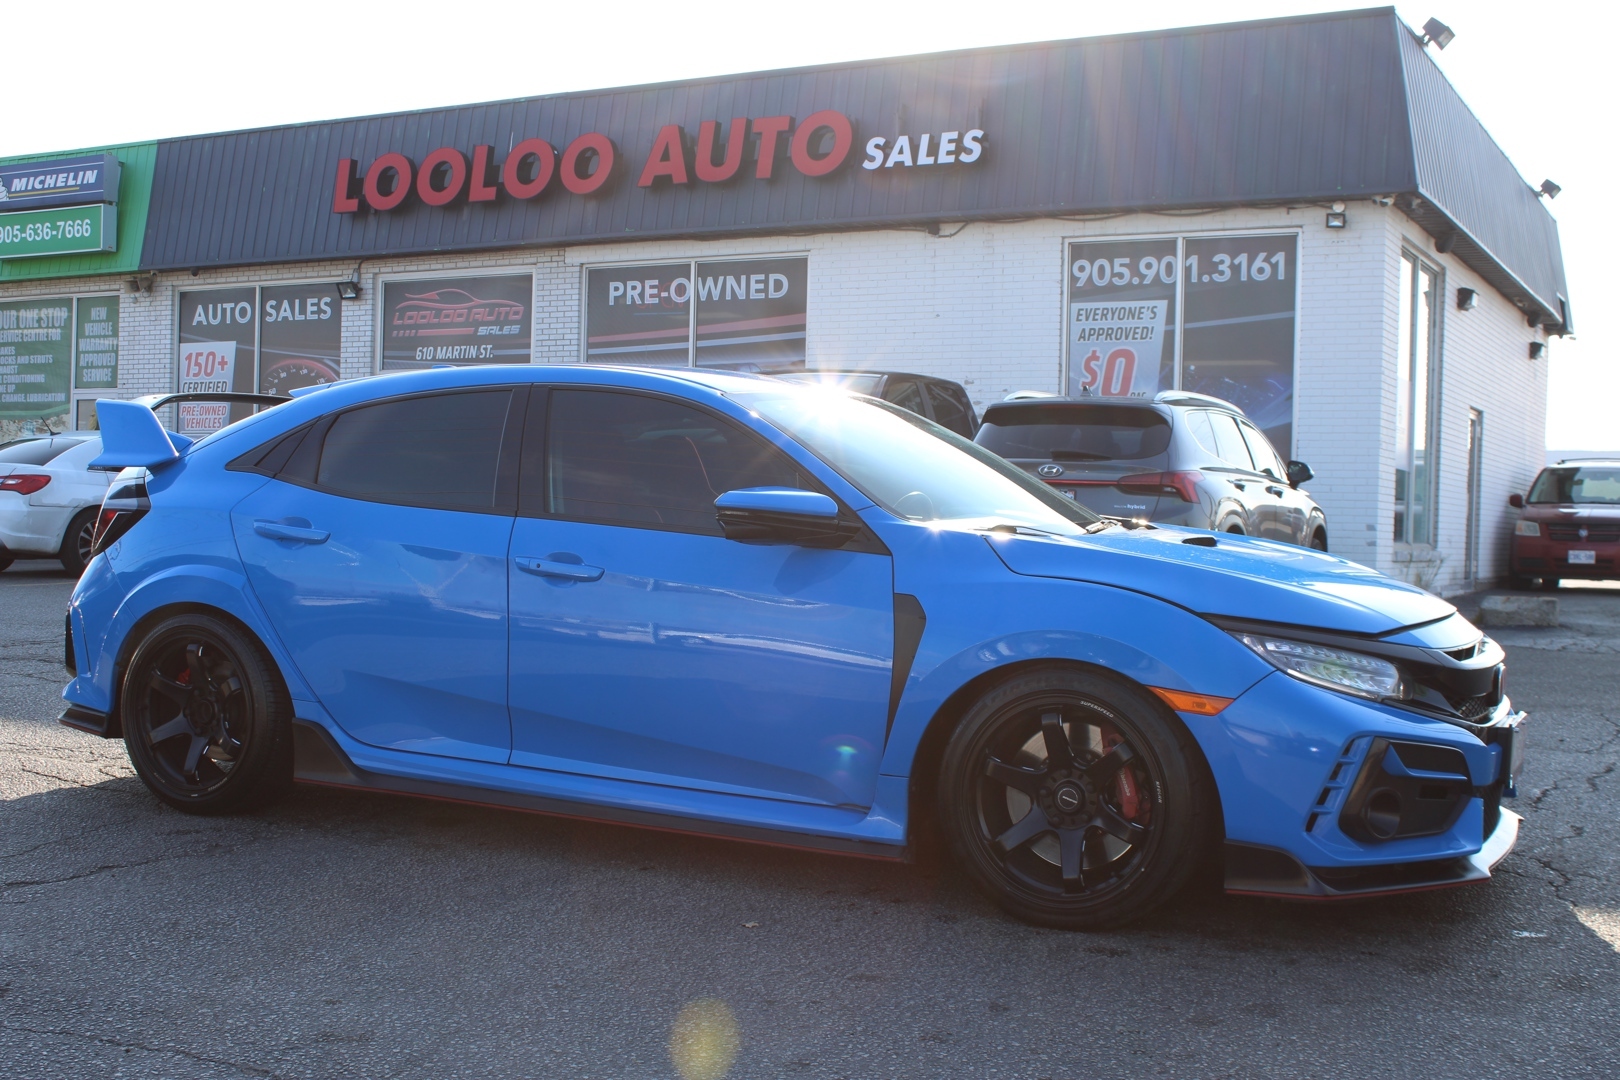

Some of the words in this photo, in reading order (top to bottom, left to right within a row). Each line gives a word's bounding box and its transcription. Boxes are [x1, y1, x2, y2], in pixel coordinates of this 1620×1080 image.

[333, 132, 615, 214] LOOLOO
[637, 109, 853, 188] AUTO
[861, 129, 985, 170] SALES
[11, 169, 98, 192] MICHELIN
[1072, 251, 1286, 287] 905.901.3161
[608, 273, 789, 306] PRE-OWNED
[19, 308, 39, 328] ONE
[40, 307, 68, 328] STOP
[91, 307, 107, 320] NEW
[192, 301, 252, 326] AUTO
[265, 297, 332, 323] SALES
[393, 309, 468, 325] LOOLOO
[469, 306, 525, 322] AUTO
[1075, 305, 1158, 322] EVERYONE'S
[23, 329, 48, 342] CENTRE
[84, 322, 113, 336] VEHICLE
[477, 325, 521, 336] SALES
[1077, 326, 1155, 342] APPROVED!
[79, 337, 118, 351] WARRANTY
[416, 346, 433, 360] 610
[436, 345, 477, 360] MARTIN
[479, 344, 494, 358] ST.
[30, 354, 53, 364] STRUTS
[79, 352, 116, 367] APPROVED
[184, 351, 228, 378] 150+
[83, 368, 112, 382] SERVICE
[1081, 348, 1136, 397] $0
[182, 380, 228, 393] CERTIFIED
[181, 405, 227, 416] PRE-OWNED
[186, 417, 222, 429] VEHICLES
